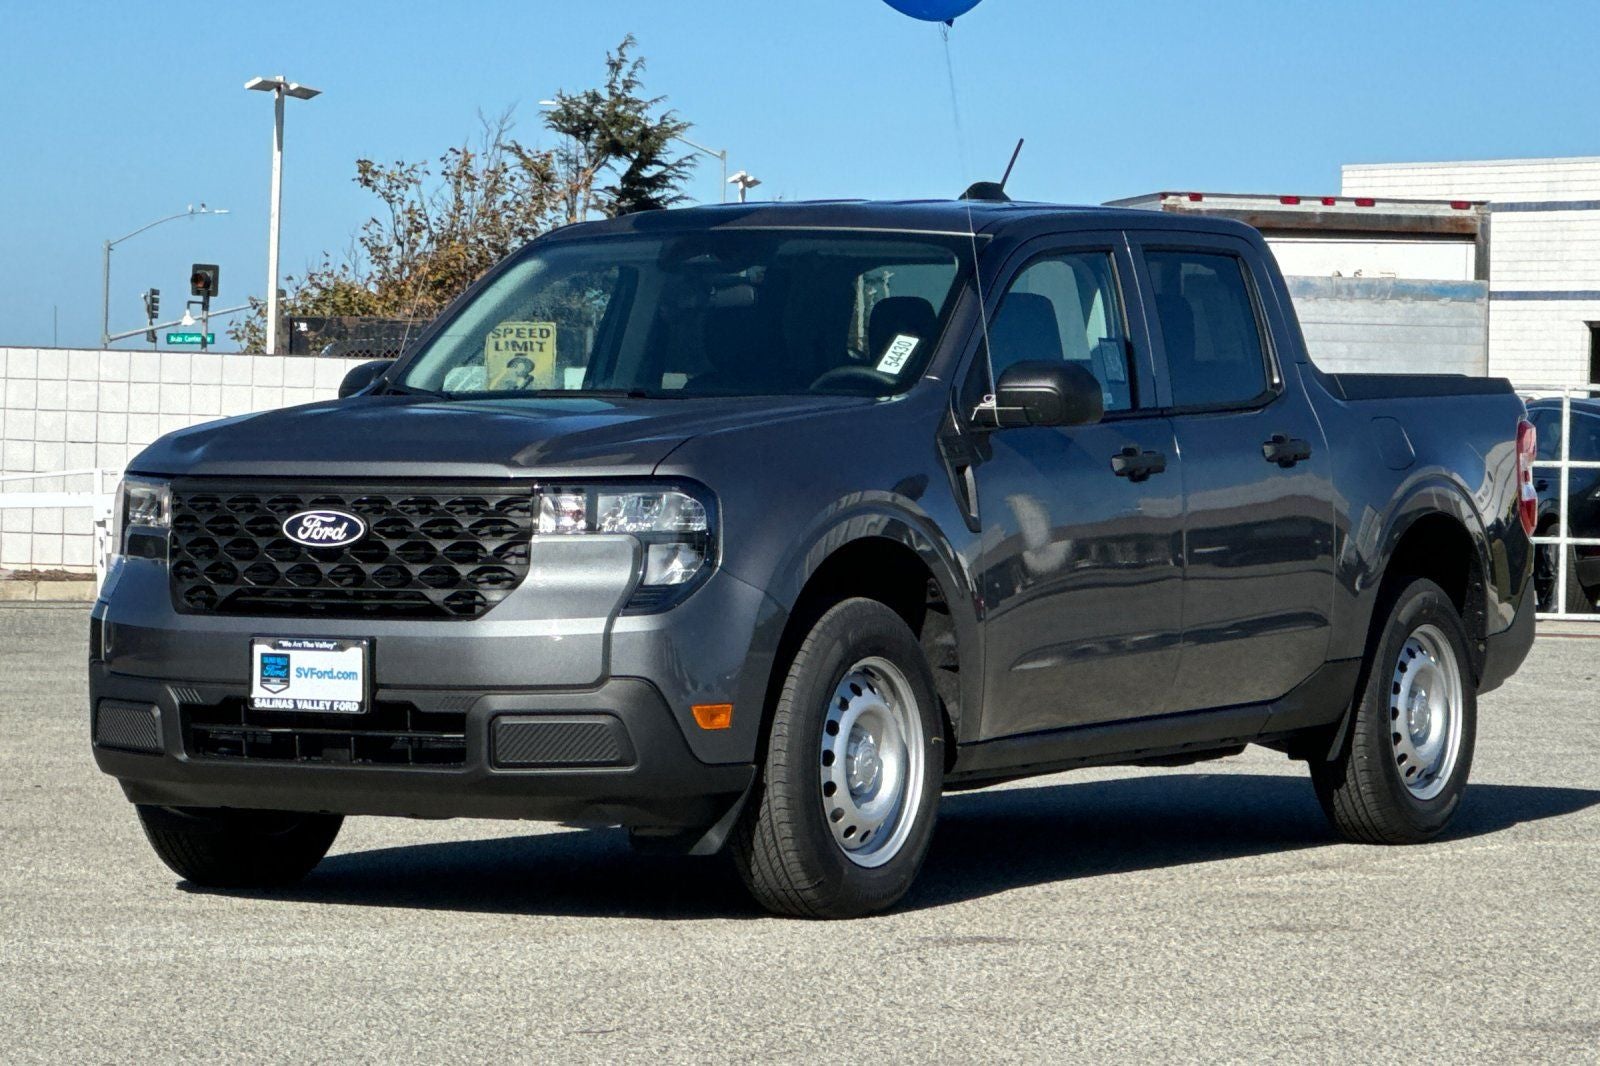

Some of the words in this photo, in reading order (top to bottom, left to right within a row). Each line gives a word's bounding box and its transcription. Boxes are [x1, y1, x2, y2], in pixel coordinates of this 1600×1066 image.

[492, 328, 551, 339] SPEED
[495, 341, 546, 352] LIMIT
[297, 515, 349, 541] Ford
[303, 641, 315, 649] The
[295, 666, 358, 681] SVFord.com
[254, 697, 294, 709] SALINAS
[296, 699, 332, 711] VALLEY
[333, 701, 359, 712] FORD
